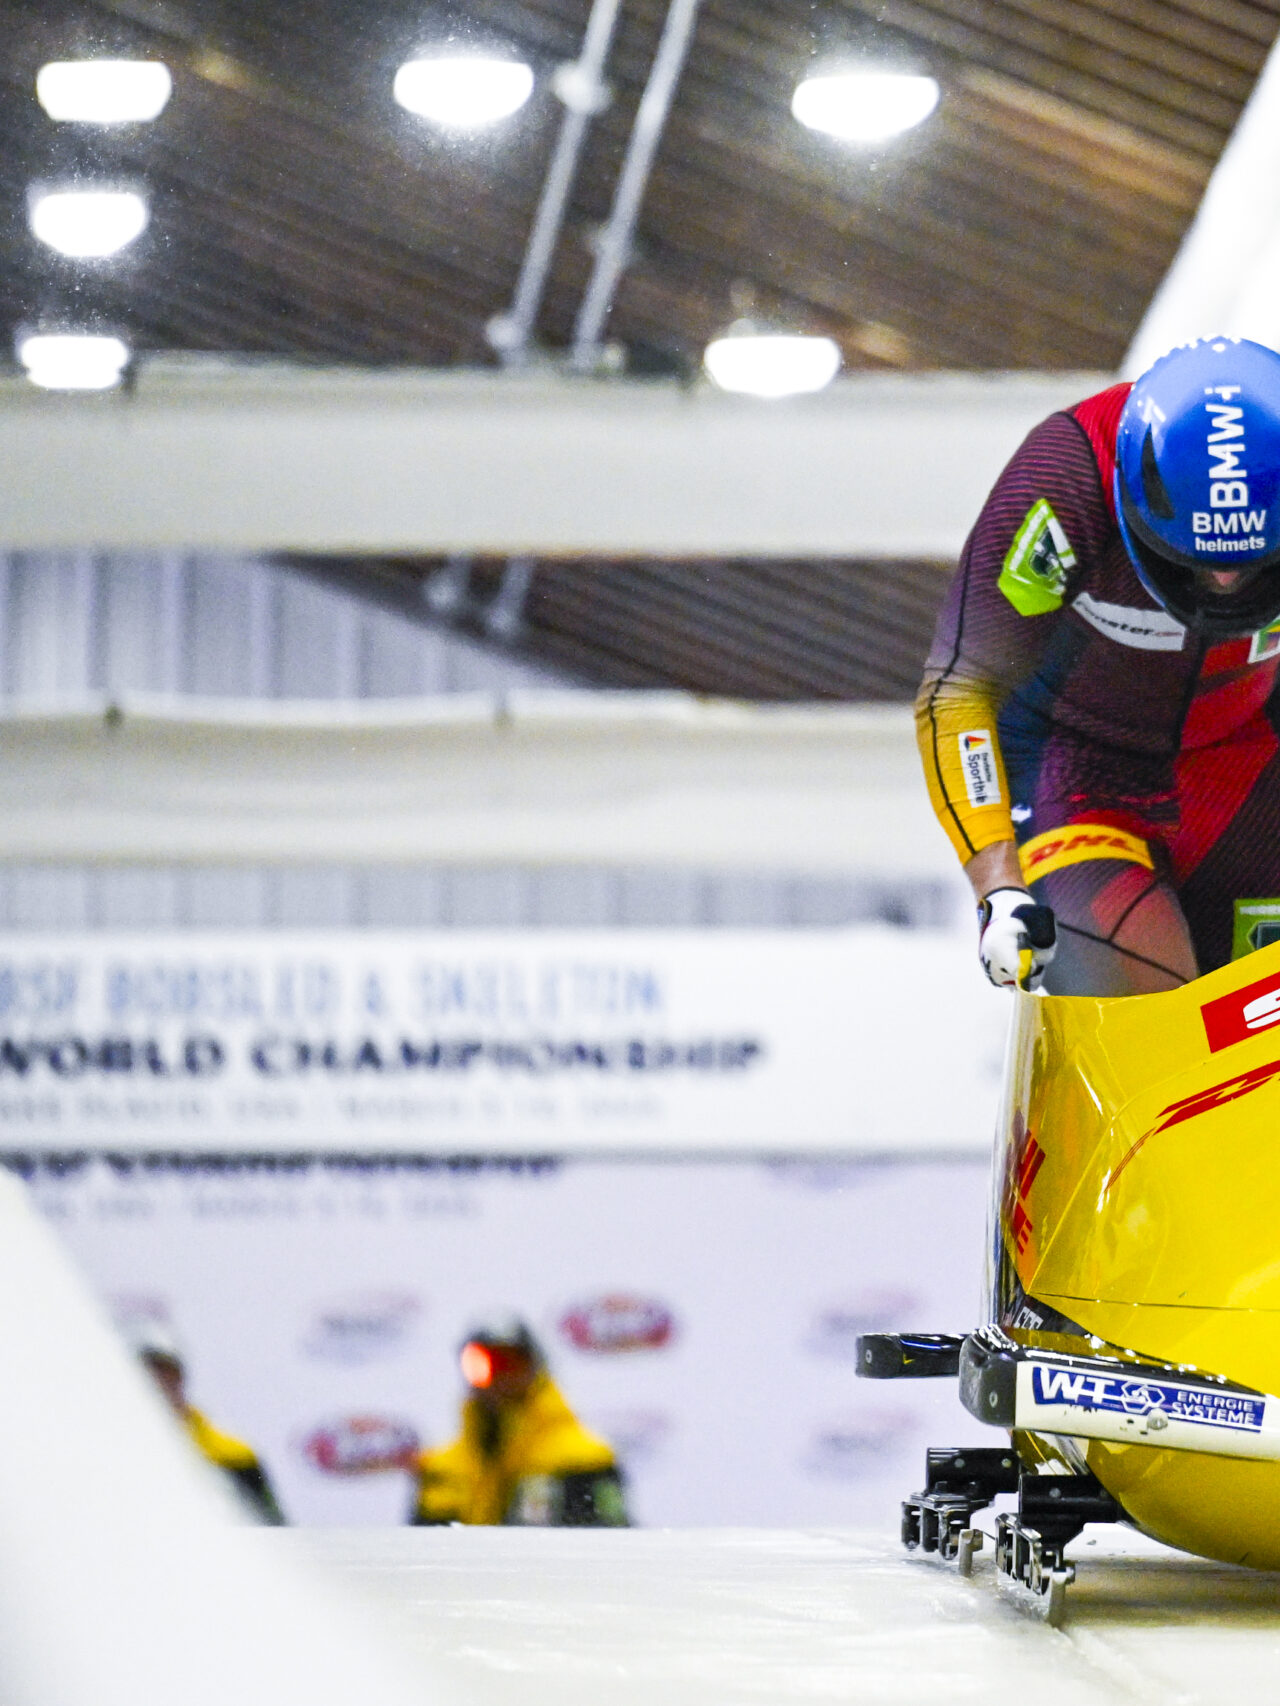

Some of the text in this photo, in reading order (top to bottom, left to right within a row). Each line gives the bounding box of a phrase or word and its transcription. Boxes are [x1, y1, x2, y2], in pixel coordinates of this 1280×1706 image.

[1204, 404, 1249, 508] BMW
[1192, 510, 1266, 534] BMW
[1195, 536, 1266, 552] helmets
[1029, 834, 1134, 868] DHL
[1040, 1367, 1254, 1413] WT ENERGIE
[1171, 1401, 1256, 1426] SYSTEME
